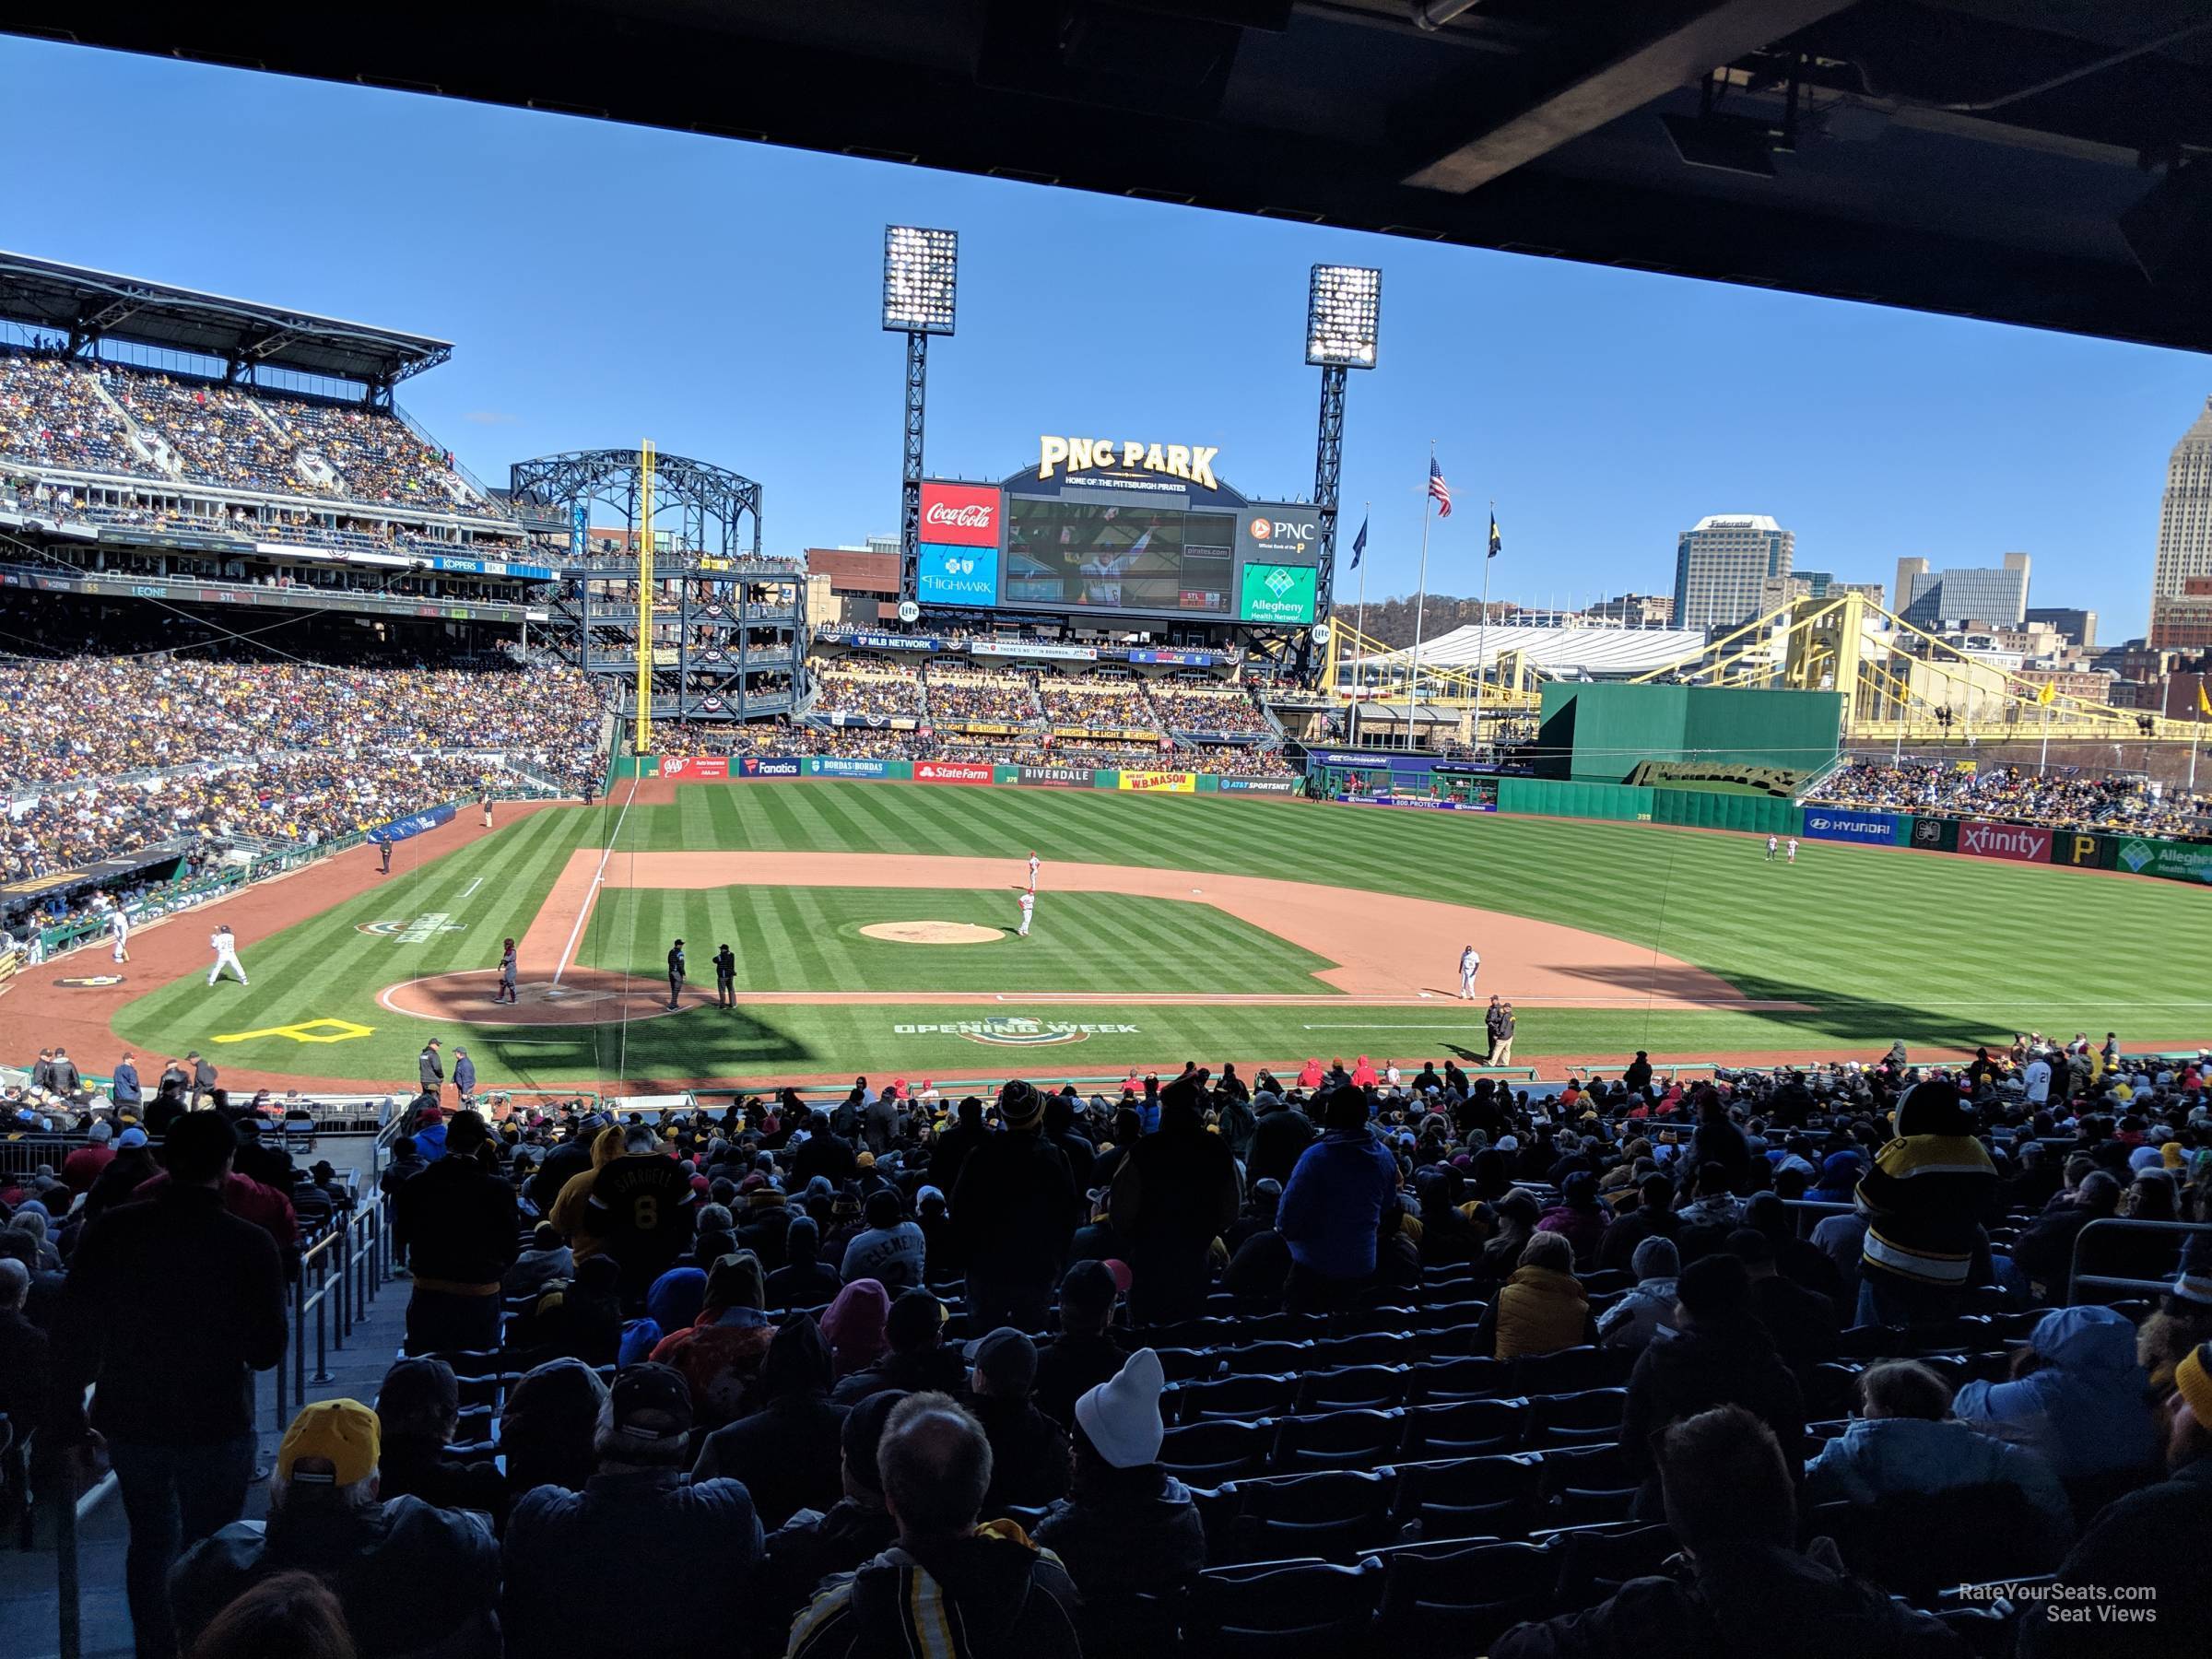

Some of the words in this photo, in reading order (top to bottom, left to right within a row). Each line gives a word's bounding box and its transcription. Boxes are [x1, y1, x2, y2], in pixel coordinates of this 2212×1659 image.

[1039, 435, 1116, 480] PNC
[1122, 441, 1218, 491] PARK
[1065, 477, 1087, 485] HOME
[1113, 480, 1157, 489] PITTSBURGH
[1158, 484, 1186, 492] PIRATES
[926, 502, 994, 527] Coca-Cola
[1274, 522, 1315, 540] PNC
[1187, 547, 1228, 556] pirates.com
[443, 559, 477, 571] KOPPERS
[87, 583, 99, 593] 55
[220, 593, 236, 602] STL
[901, 605, 918, 616] Lite
[1252, 599, 1303, 613] Allegheny
[470, 610, 476, 618] 3
[1314, 629, 1329, 638] Lite
[868, 638, 887, 646] MLB
[888, 638, 932, 649] NETWORK
[1344, 755, 1387, 763] GUARDIAN
[759, 762, 797, 774] Fanatics
[824, 760, 852, 771] BORDAS
[854, 761, 883, 771] BORDAS
[1025, 769, 1088, 781] RIVENDALE
[1392, 799, 1441, 808] 1.800.PROTECT
[1833, 821, 1890, 834] HYUNDAI
[1964, 826, 2045, 859] xfinity
[2073, 836, 2096, 864] P
[2158, 864, 2185, 874] Health
[894, 1023, 1039, 1033] OPENING
[1046, 1023, 1141, 1033] WEEK
[2040, 1072, 2048, 1083] 21
[634, 1194, 657, 1230] 8
